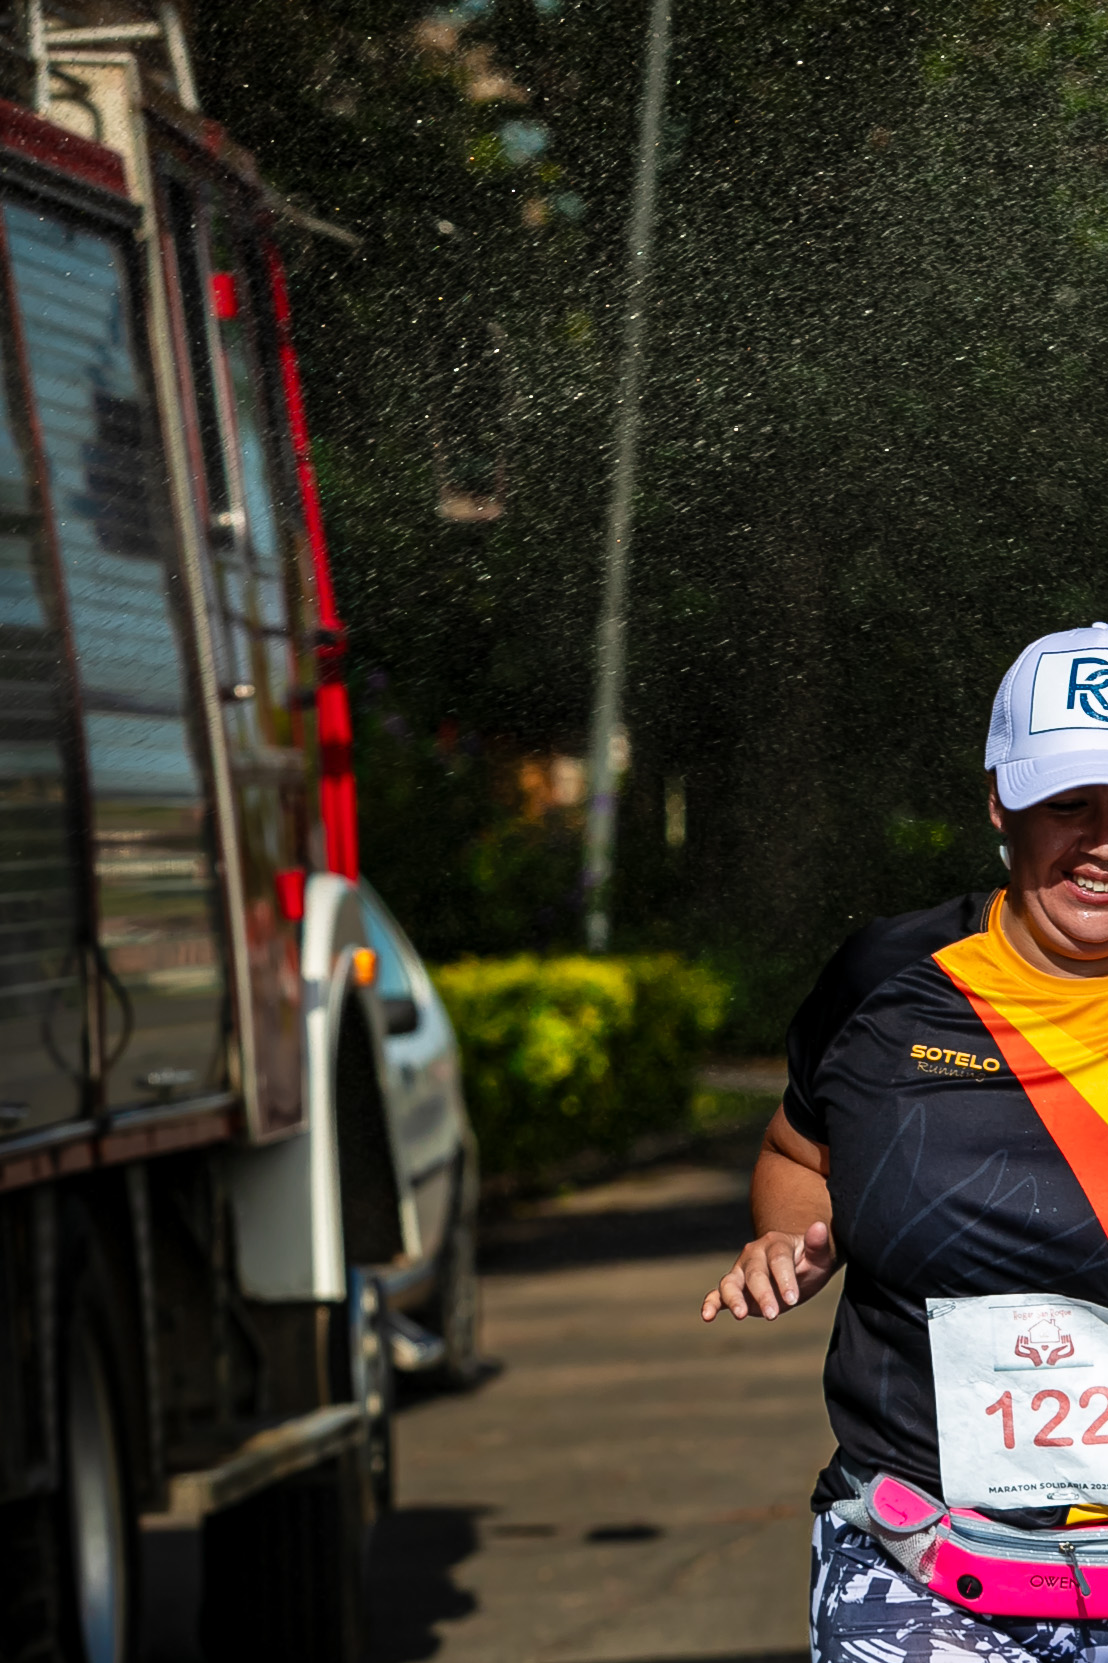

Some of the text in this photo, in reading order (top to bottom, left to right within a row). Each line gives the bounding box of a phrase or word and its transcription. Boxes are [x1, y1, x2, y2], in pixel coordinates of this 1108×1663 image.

[910, 1044, 1001, 1072] SOTELO
[916, 1061, 986, 1083] Running
[988, 1484, 1038, 1494] MARATON
[1040, 1481, 1089, 1491] SOLIDARIA
